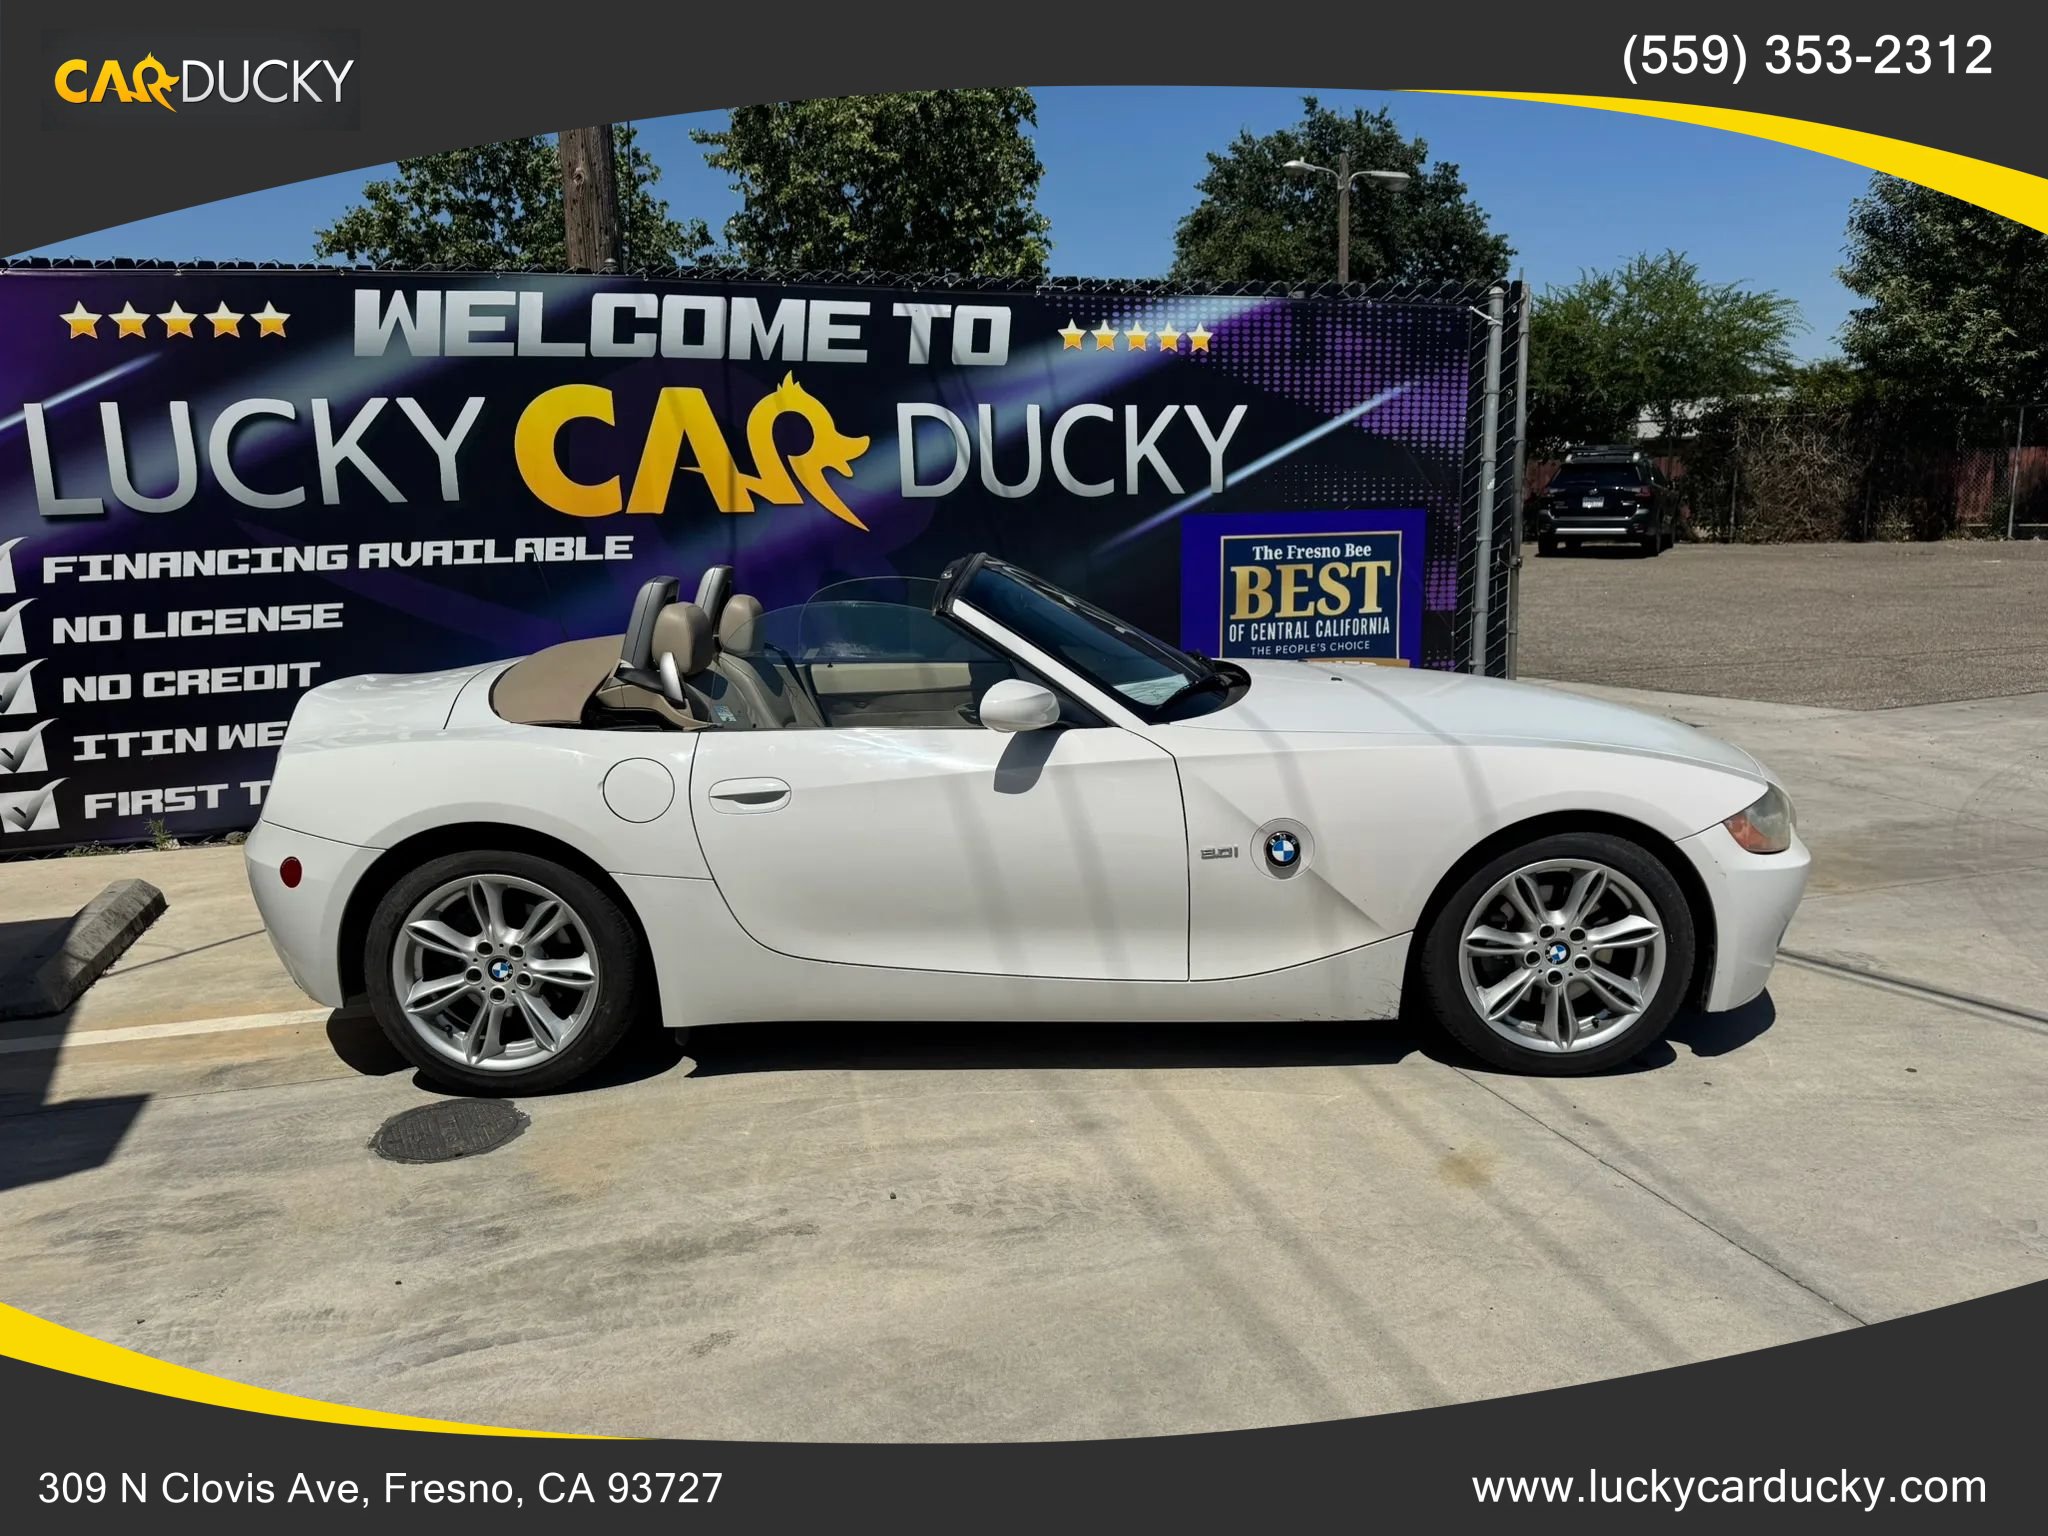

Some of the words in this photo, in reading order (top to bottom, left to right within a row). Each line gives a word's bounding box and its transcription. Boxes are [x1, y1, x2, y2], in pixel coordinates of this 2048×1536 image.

[354, 288, 871, 364] WELCOME
[892, 303, 1012, 366] TO
[23, 396, 486, 517] LUCKY
[896, 402, 1248, 499] DUCKY
[42, 544, 349, 584] FINANCING
[358, 535, 635, 570] AVAILABLE
[1252, 545, 1283, 560] The
[1286, 544, 1341, 560] Fresno
[1345, 542, 1372, 557] Bee
[1230, 560, 1392, 620] BEST
[52, 615, 122, 645] NO
[133, 602, 344, 640] LICENSE
[1229, 624, 1245, 642] OF
[1251, 621, 1310, 642] CENTRAL
[1315, 616, 1390, 638] CALIFORNIA
[1251, 646, 1271, 656] THE
[1275, 642, 1326, 654] PEOPLE'S
[1329, 640, 1371, 651] CHOICE
[62, 673, 132, 704] NO
[143, 661, 321, 697] CREDIT
[73, 726, 207, 762] ITIN
[84, 783, 229, 819] FIRST
